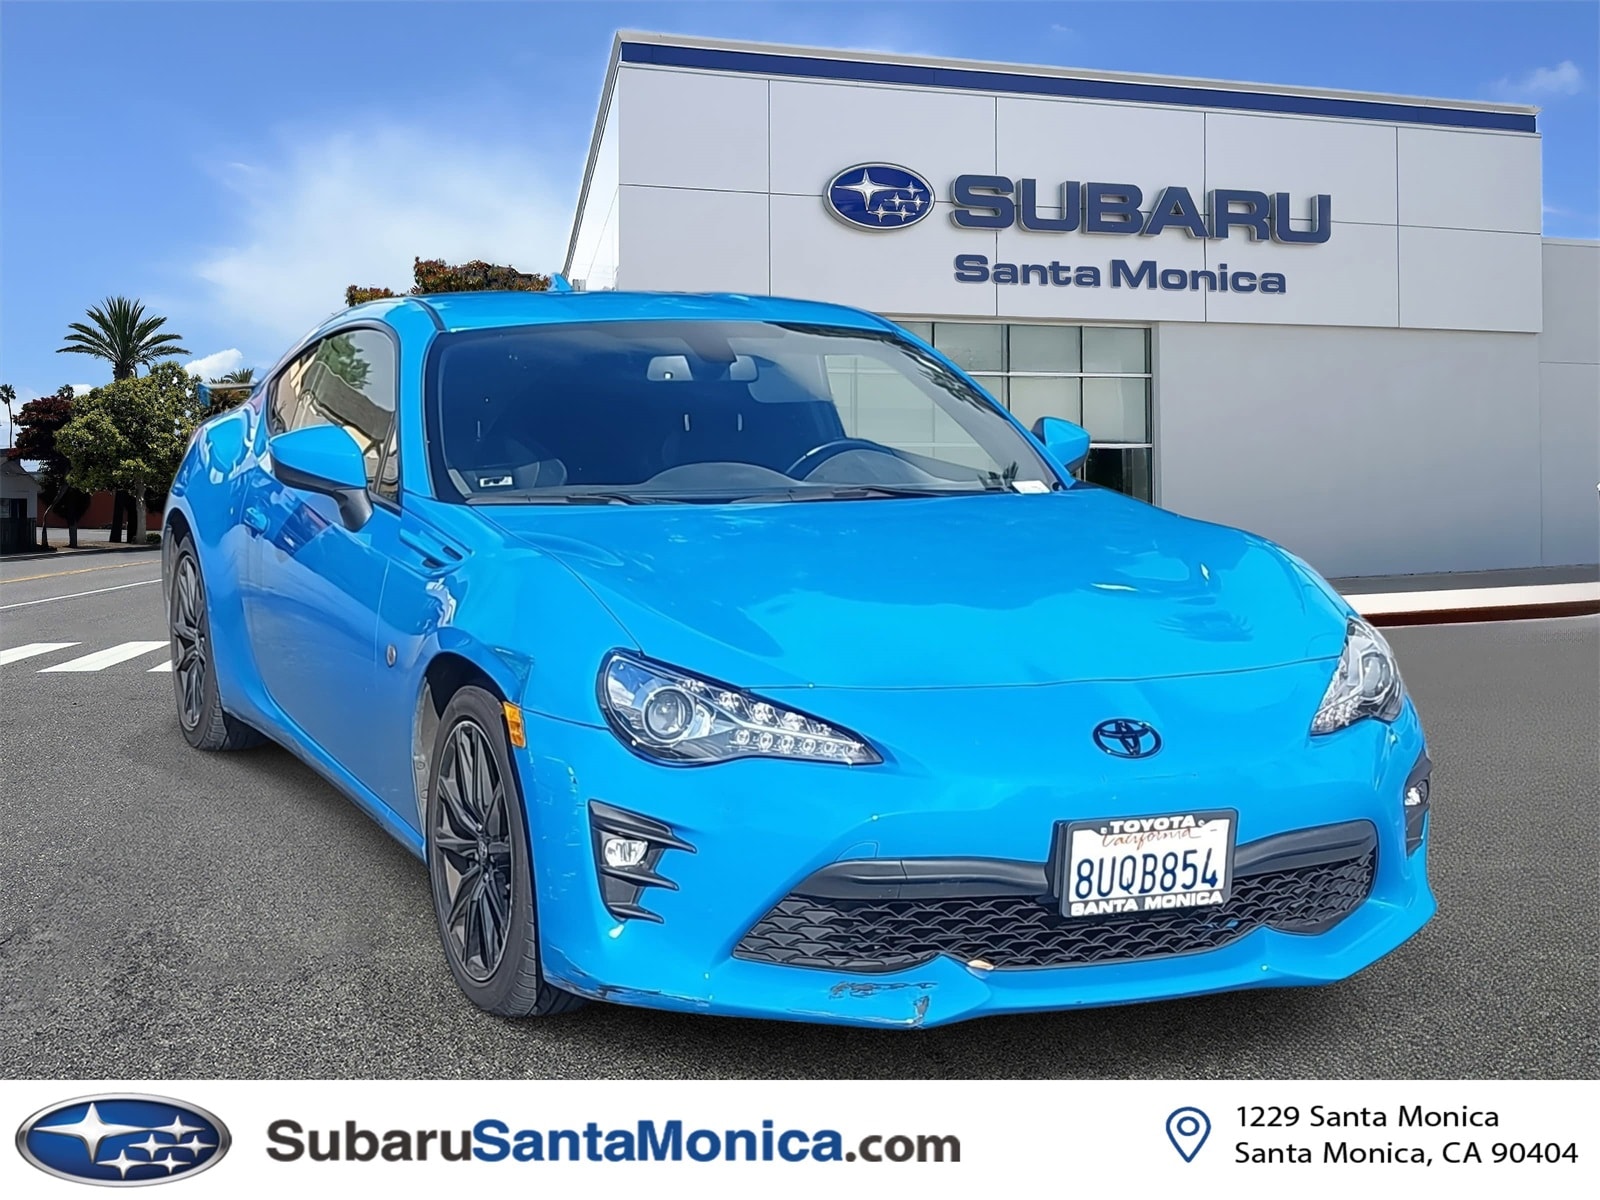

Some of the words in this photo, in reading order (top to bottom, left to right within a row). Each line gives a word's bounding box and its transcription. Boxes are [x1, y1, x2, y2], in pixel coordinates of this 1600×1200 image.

[950, 174, 1331, 244] SUBARU
[955, 254, 1101, 288] Santa
[1110, 259, 1287, 294] Monica
[1110, 814, 1196, 834] TOYOTA
[1074, 847, 1219, 900] 8UQB854
[1070, 898, 1140, 917] SANTA
[1144, 890, 1224, 910] MONICA
